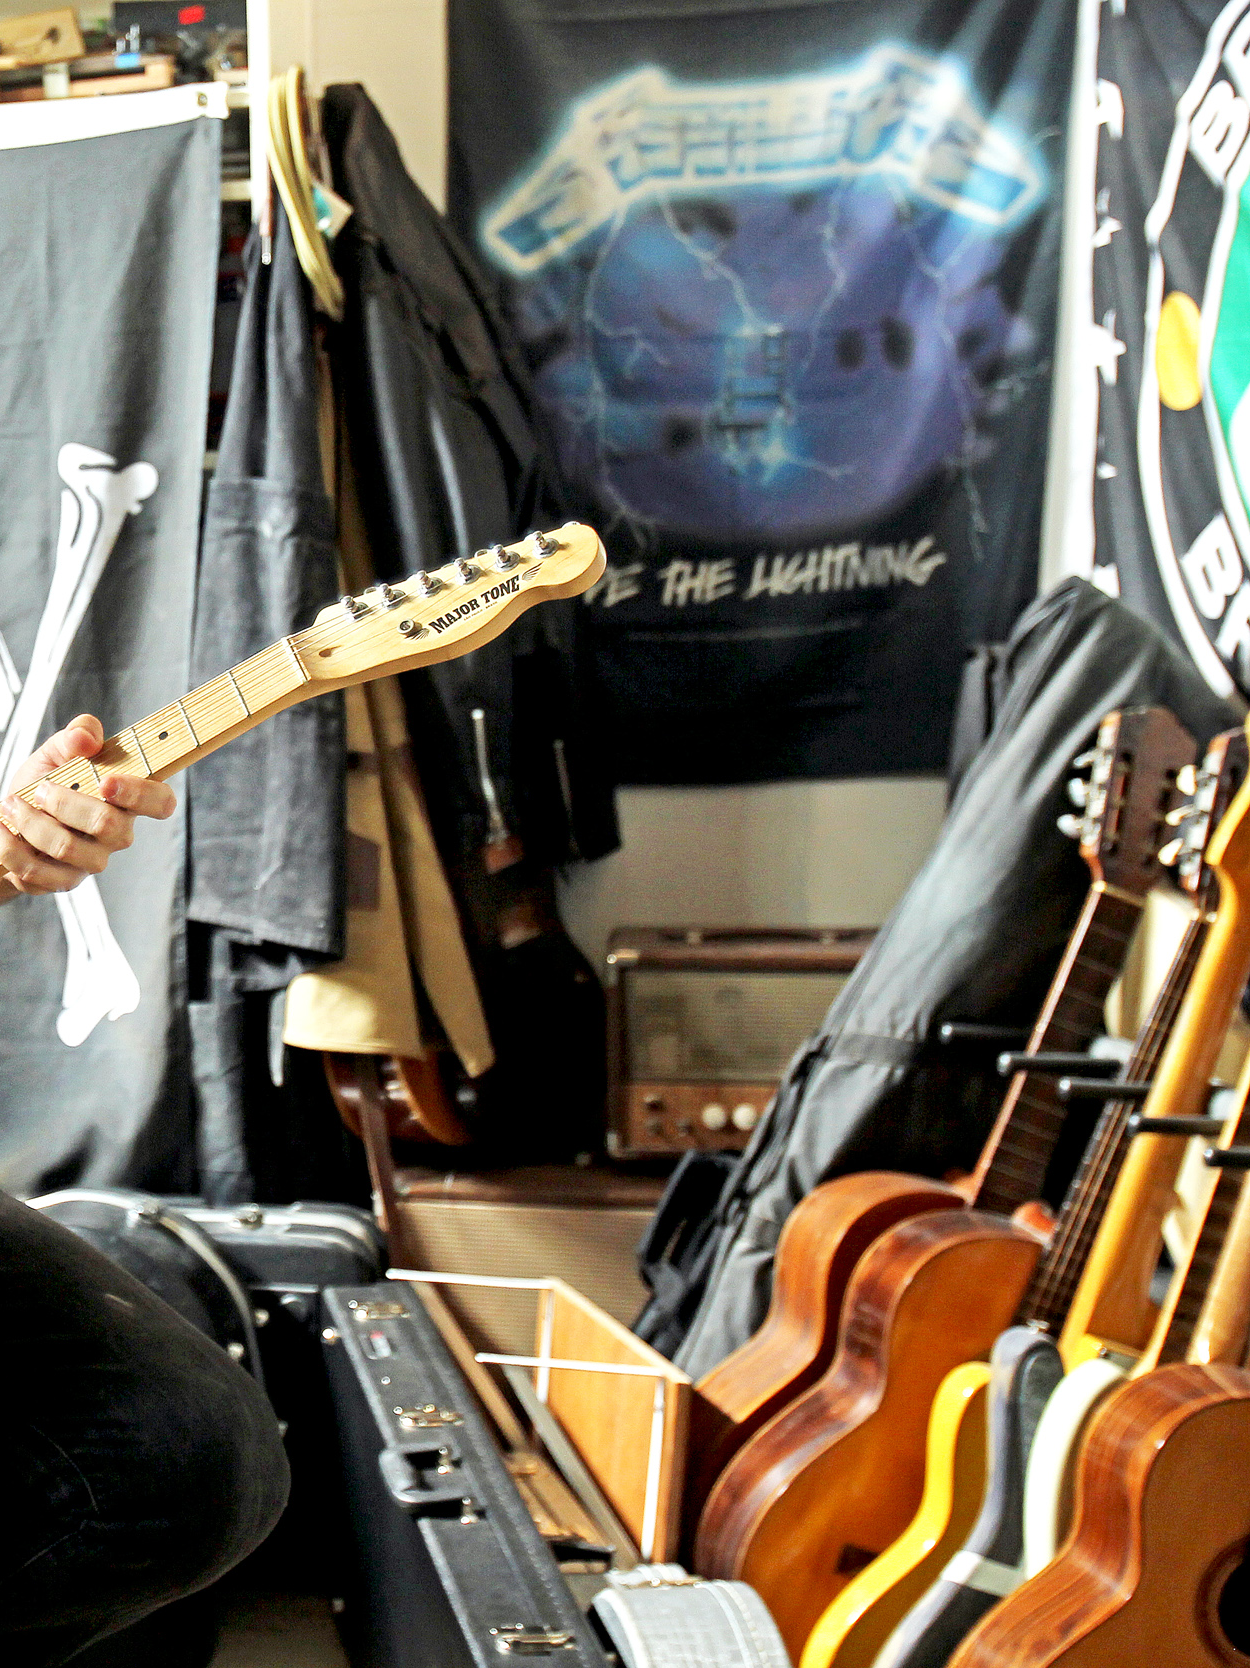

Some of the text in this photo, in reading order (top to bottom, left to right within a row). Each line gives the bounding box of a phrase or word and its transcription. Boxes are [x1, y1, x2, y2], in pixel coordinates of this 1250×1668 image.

[658, 557, 738, 607] THE
[743, 534, 948, 601] LIGHTNING
[428, 598, 481, 635] MAJOR
[480, 574, 520, 604] TONE
